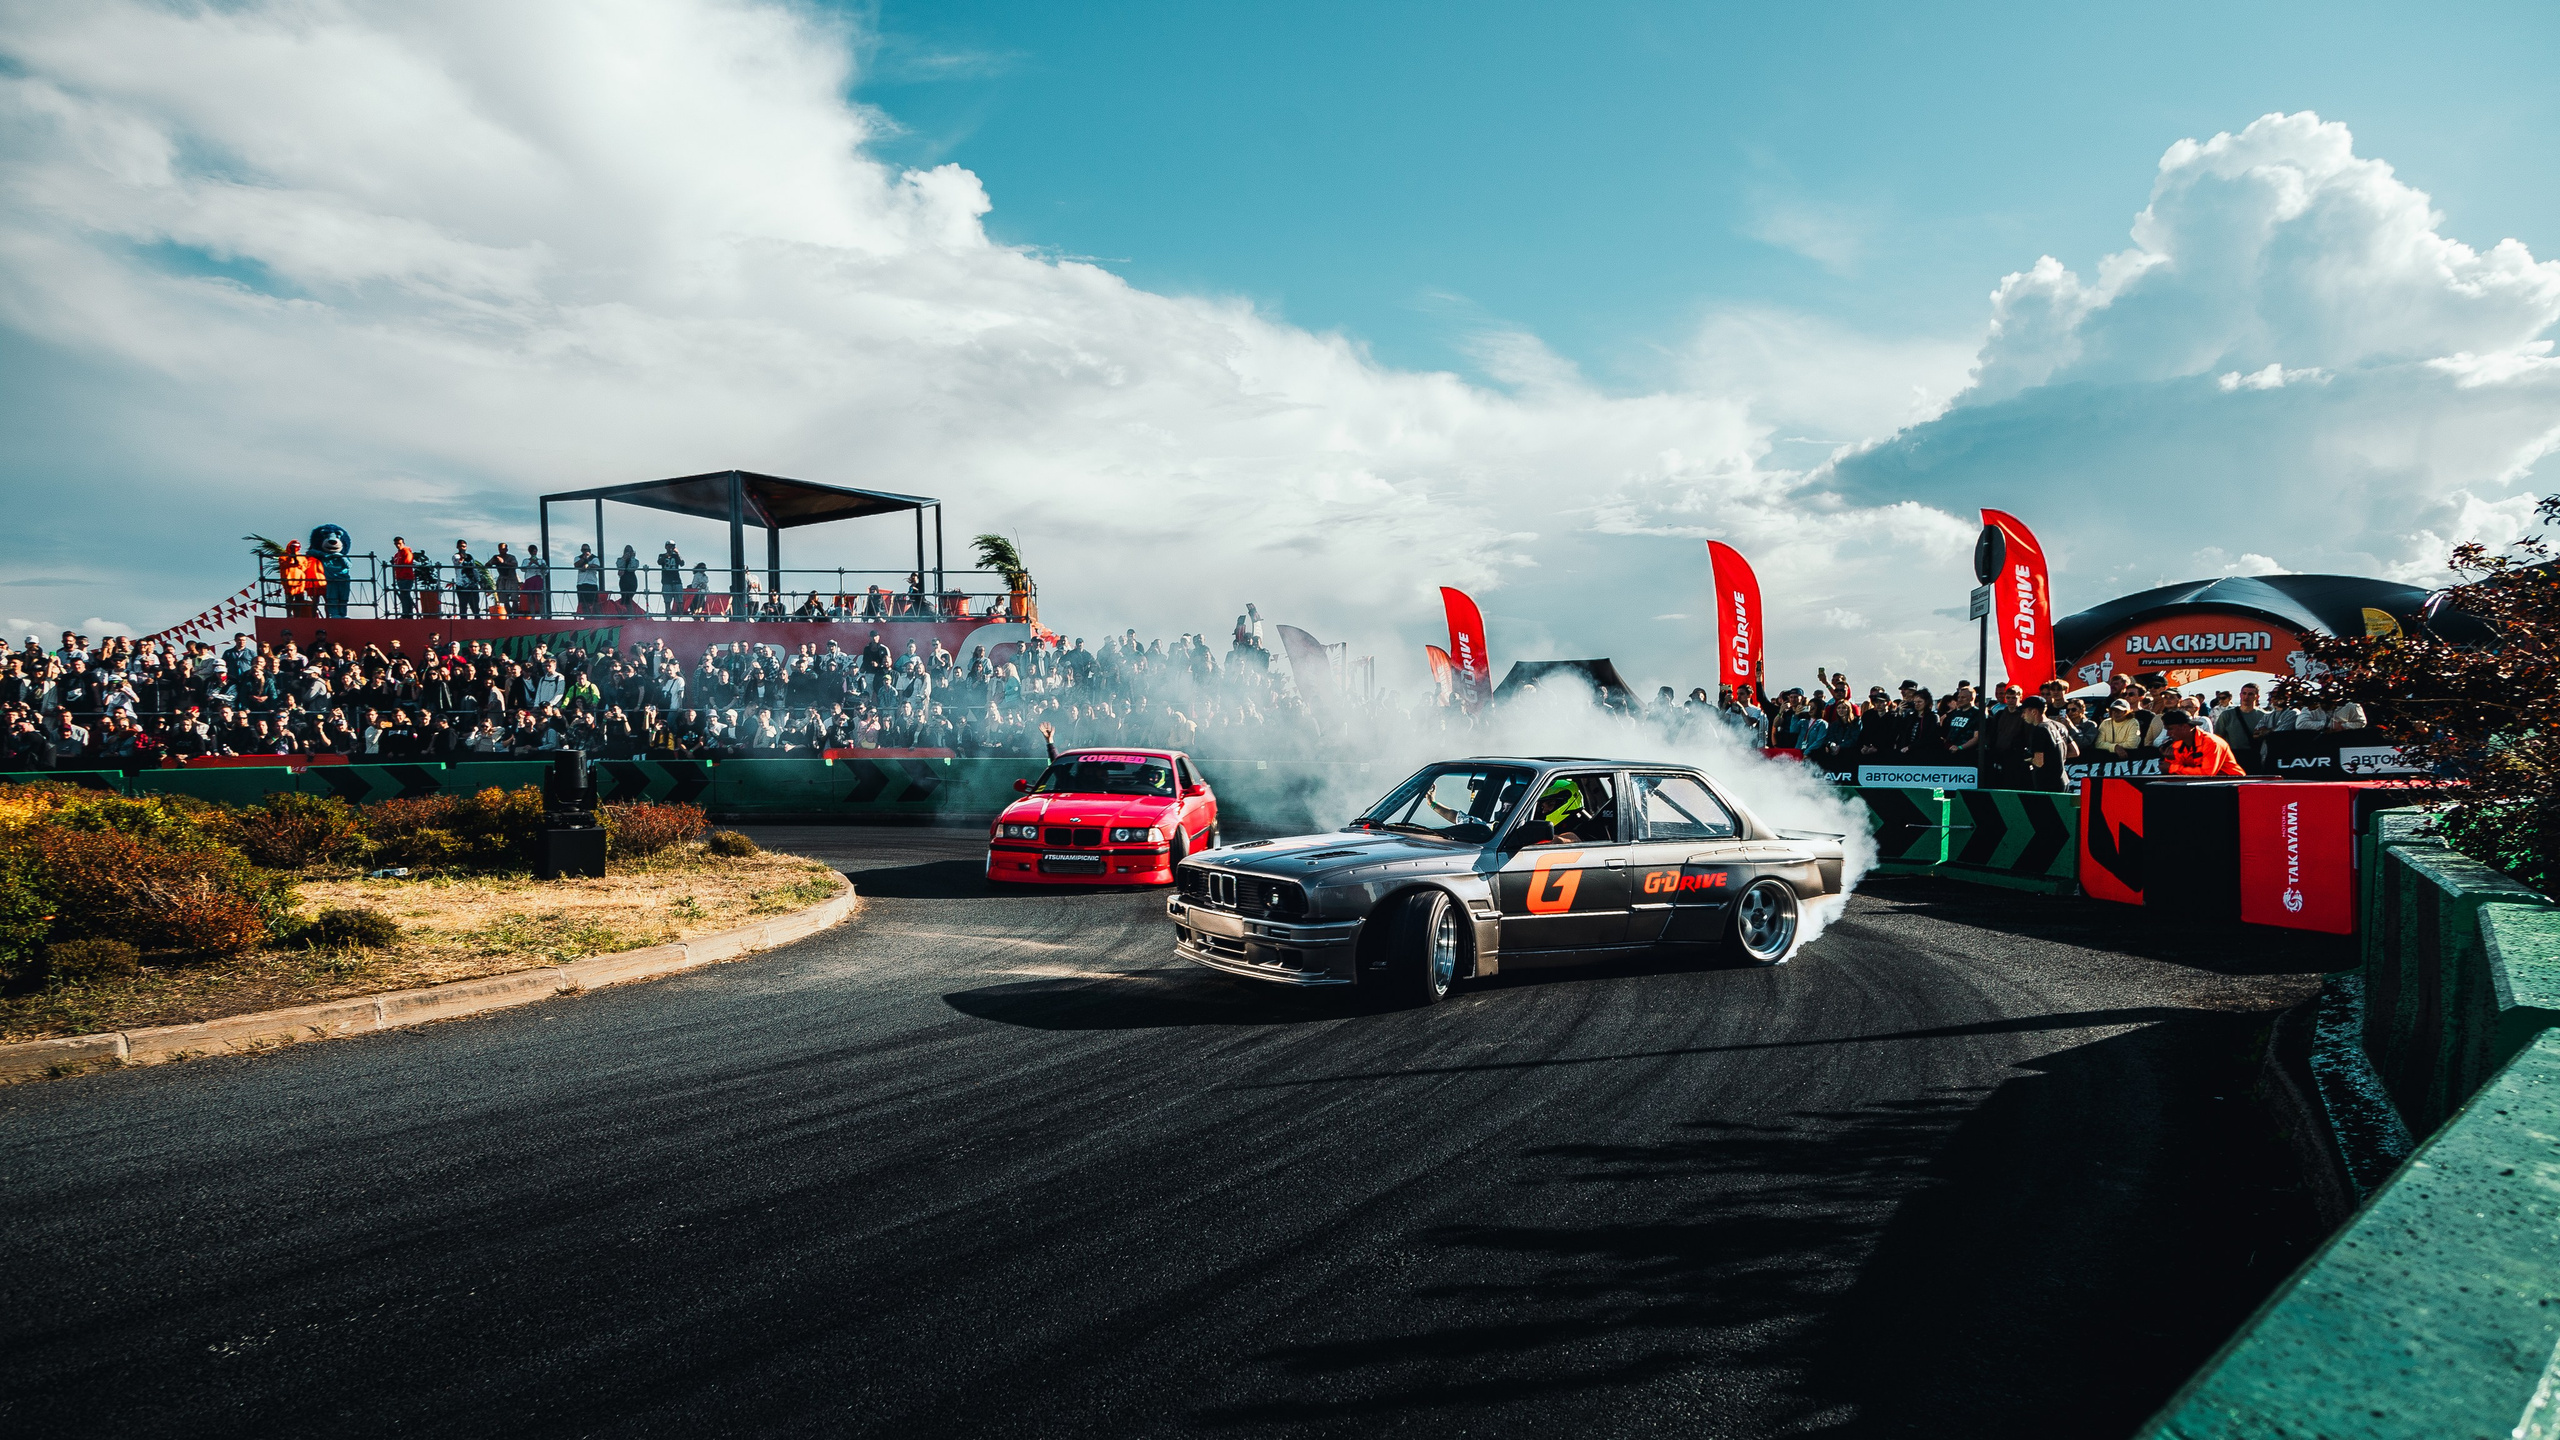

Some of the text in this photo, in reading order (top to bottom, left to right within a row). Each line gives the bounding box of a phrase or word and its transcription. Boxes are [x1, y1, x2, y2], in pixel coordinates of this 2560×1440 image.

[1078, 754, 1148, 764] CODERED
[2277, 757, 2331, 769] LAVR
[1865, 771, 1976, 784] автокосметика
[2287, 801, 2299, 885] TAKAYAMA
